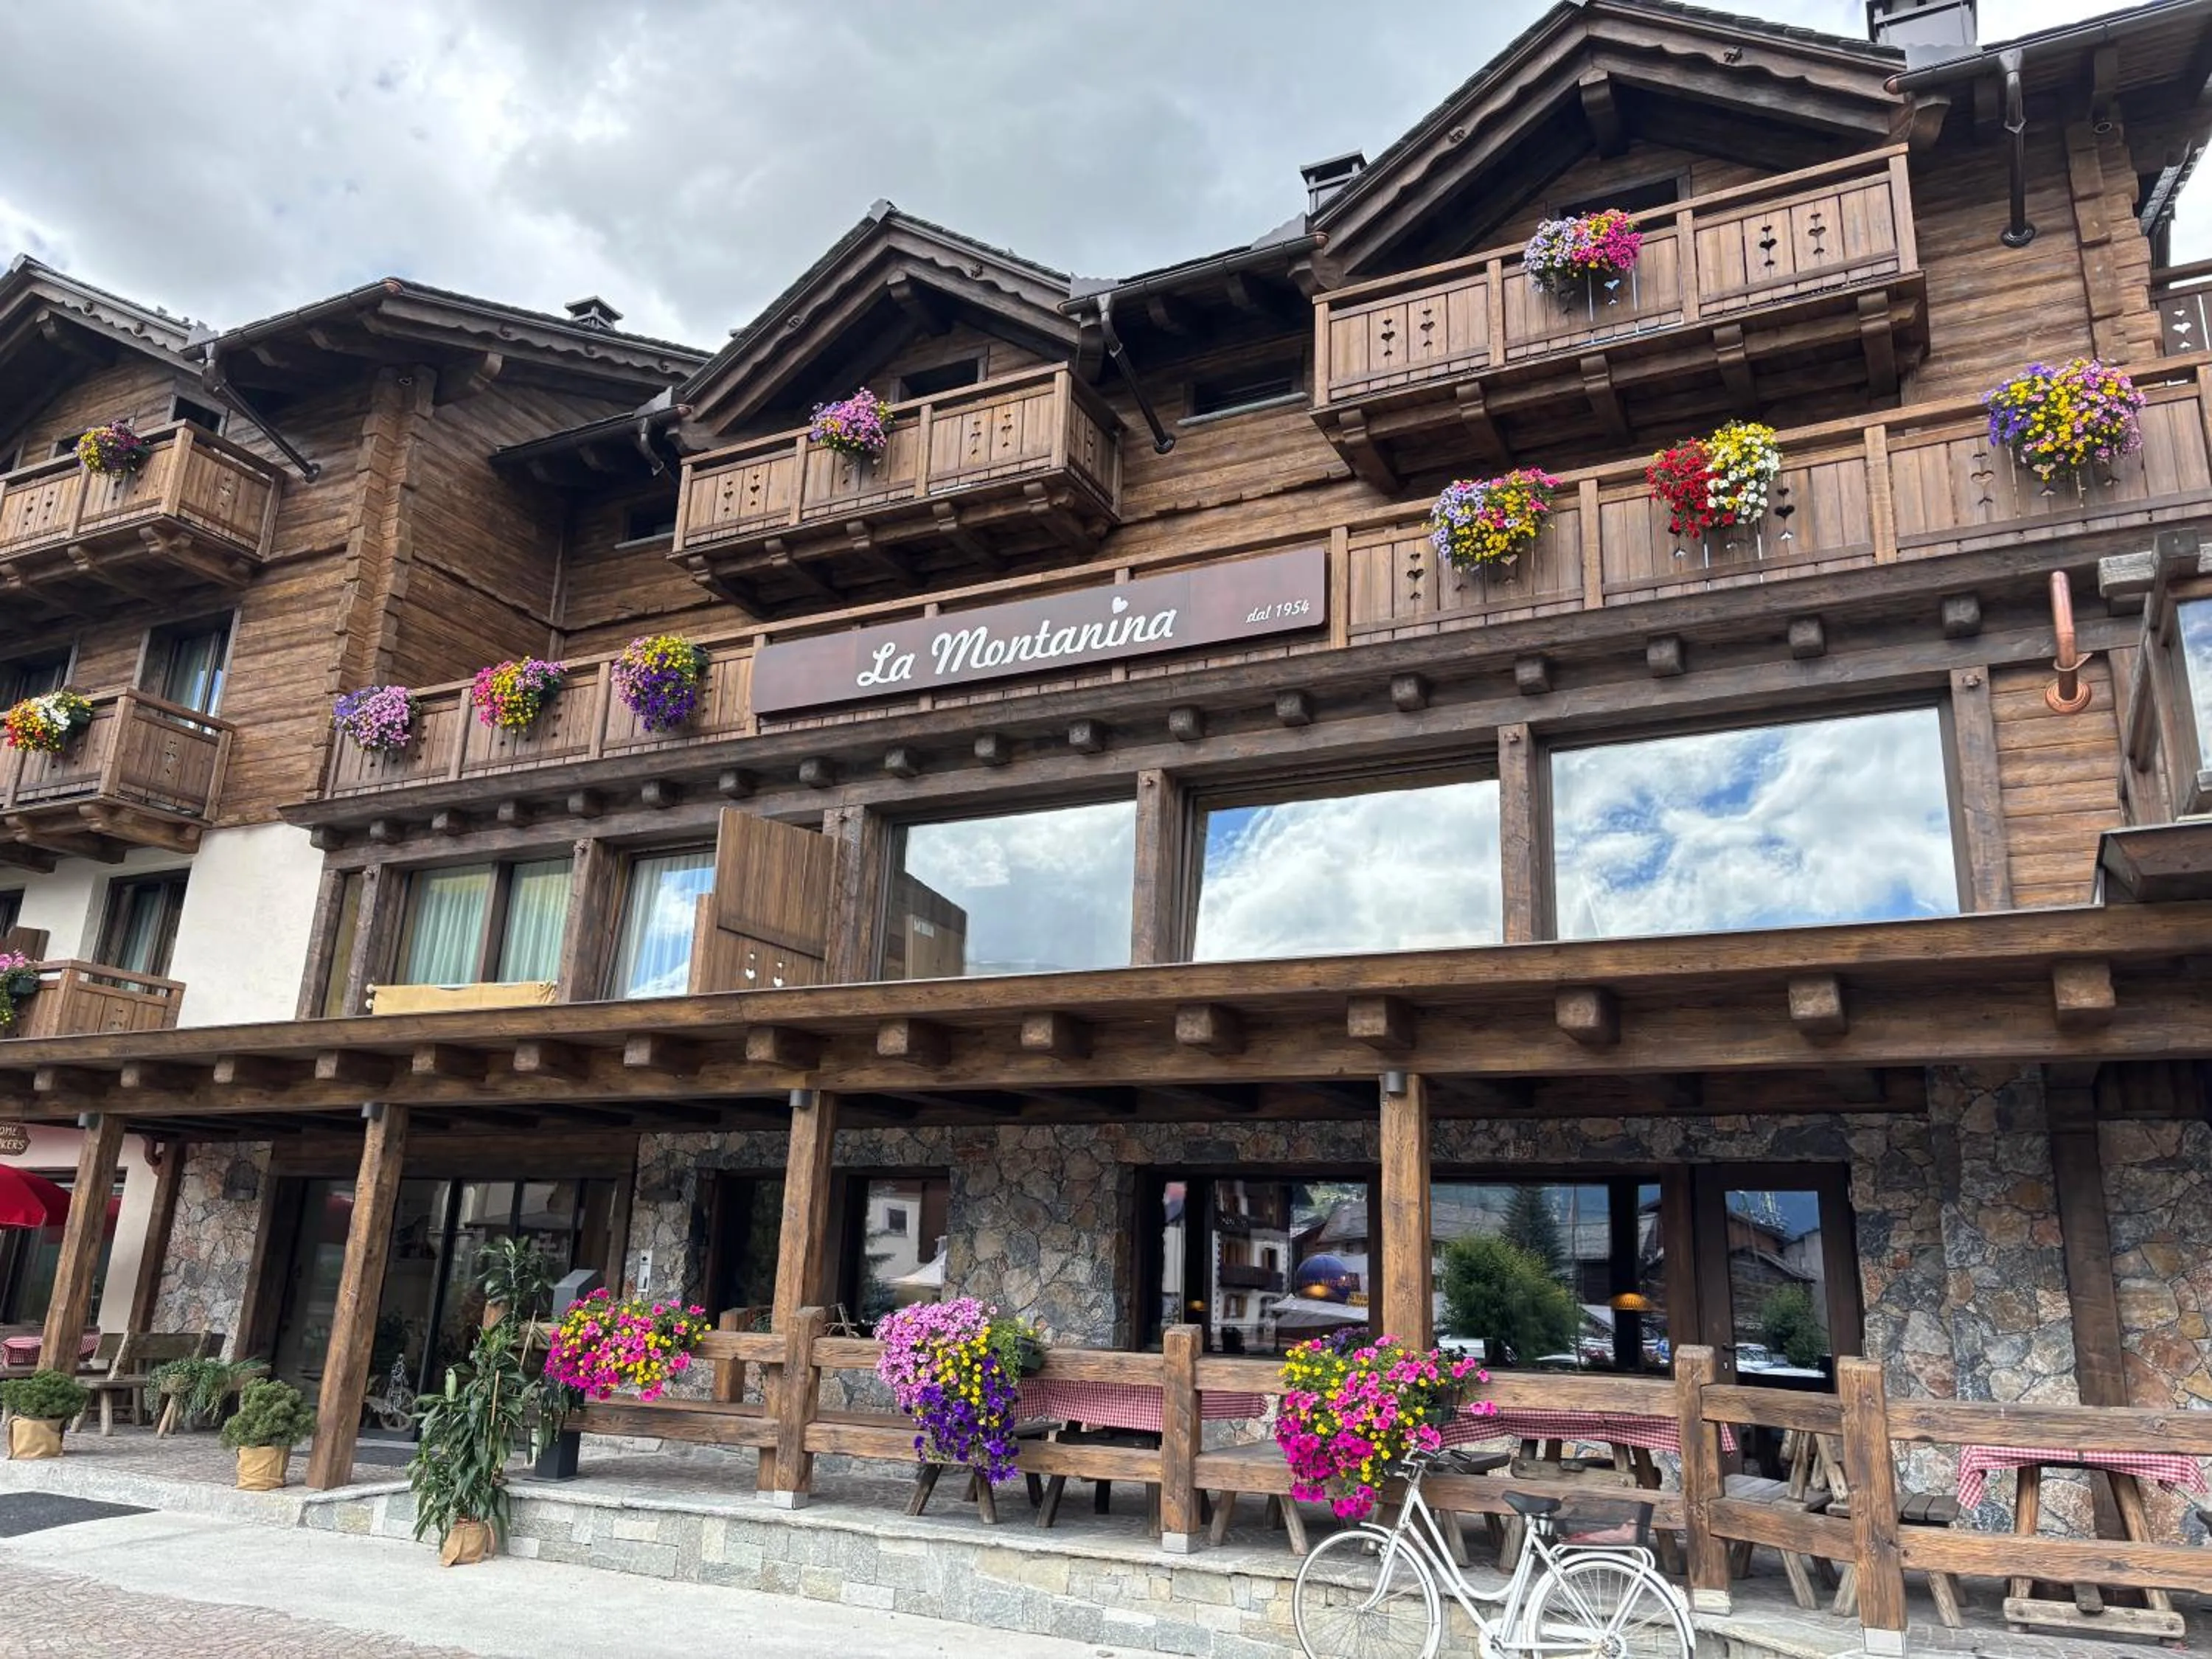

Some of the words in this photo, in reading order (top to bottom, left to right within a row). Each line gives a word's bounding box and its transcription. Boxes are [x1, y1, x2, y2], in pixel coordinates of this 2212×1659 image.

[1245, 605, 1272, 623] dal
[1276, 599, 1310, 618] 1954
[857, 642, 915, 686] La
[931, 597, 1178, 675] Montanina
